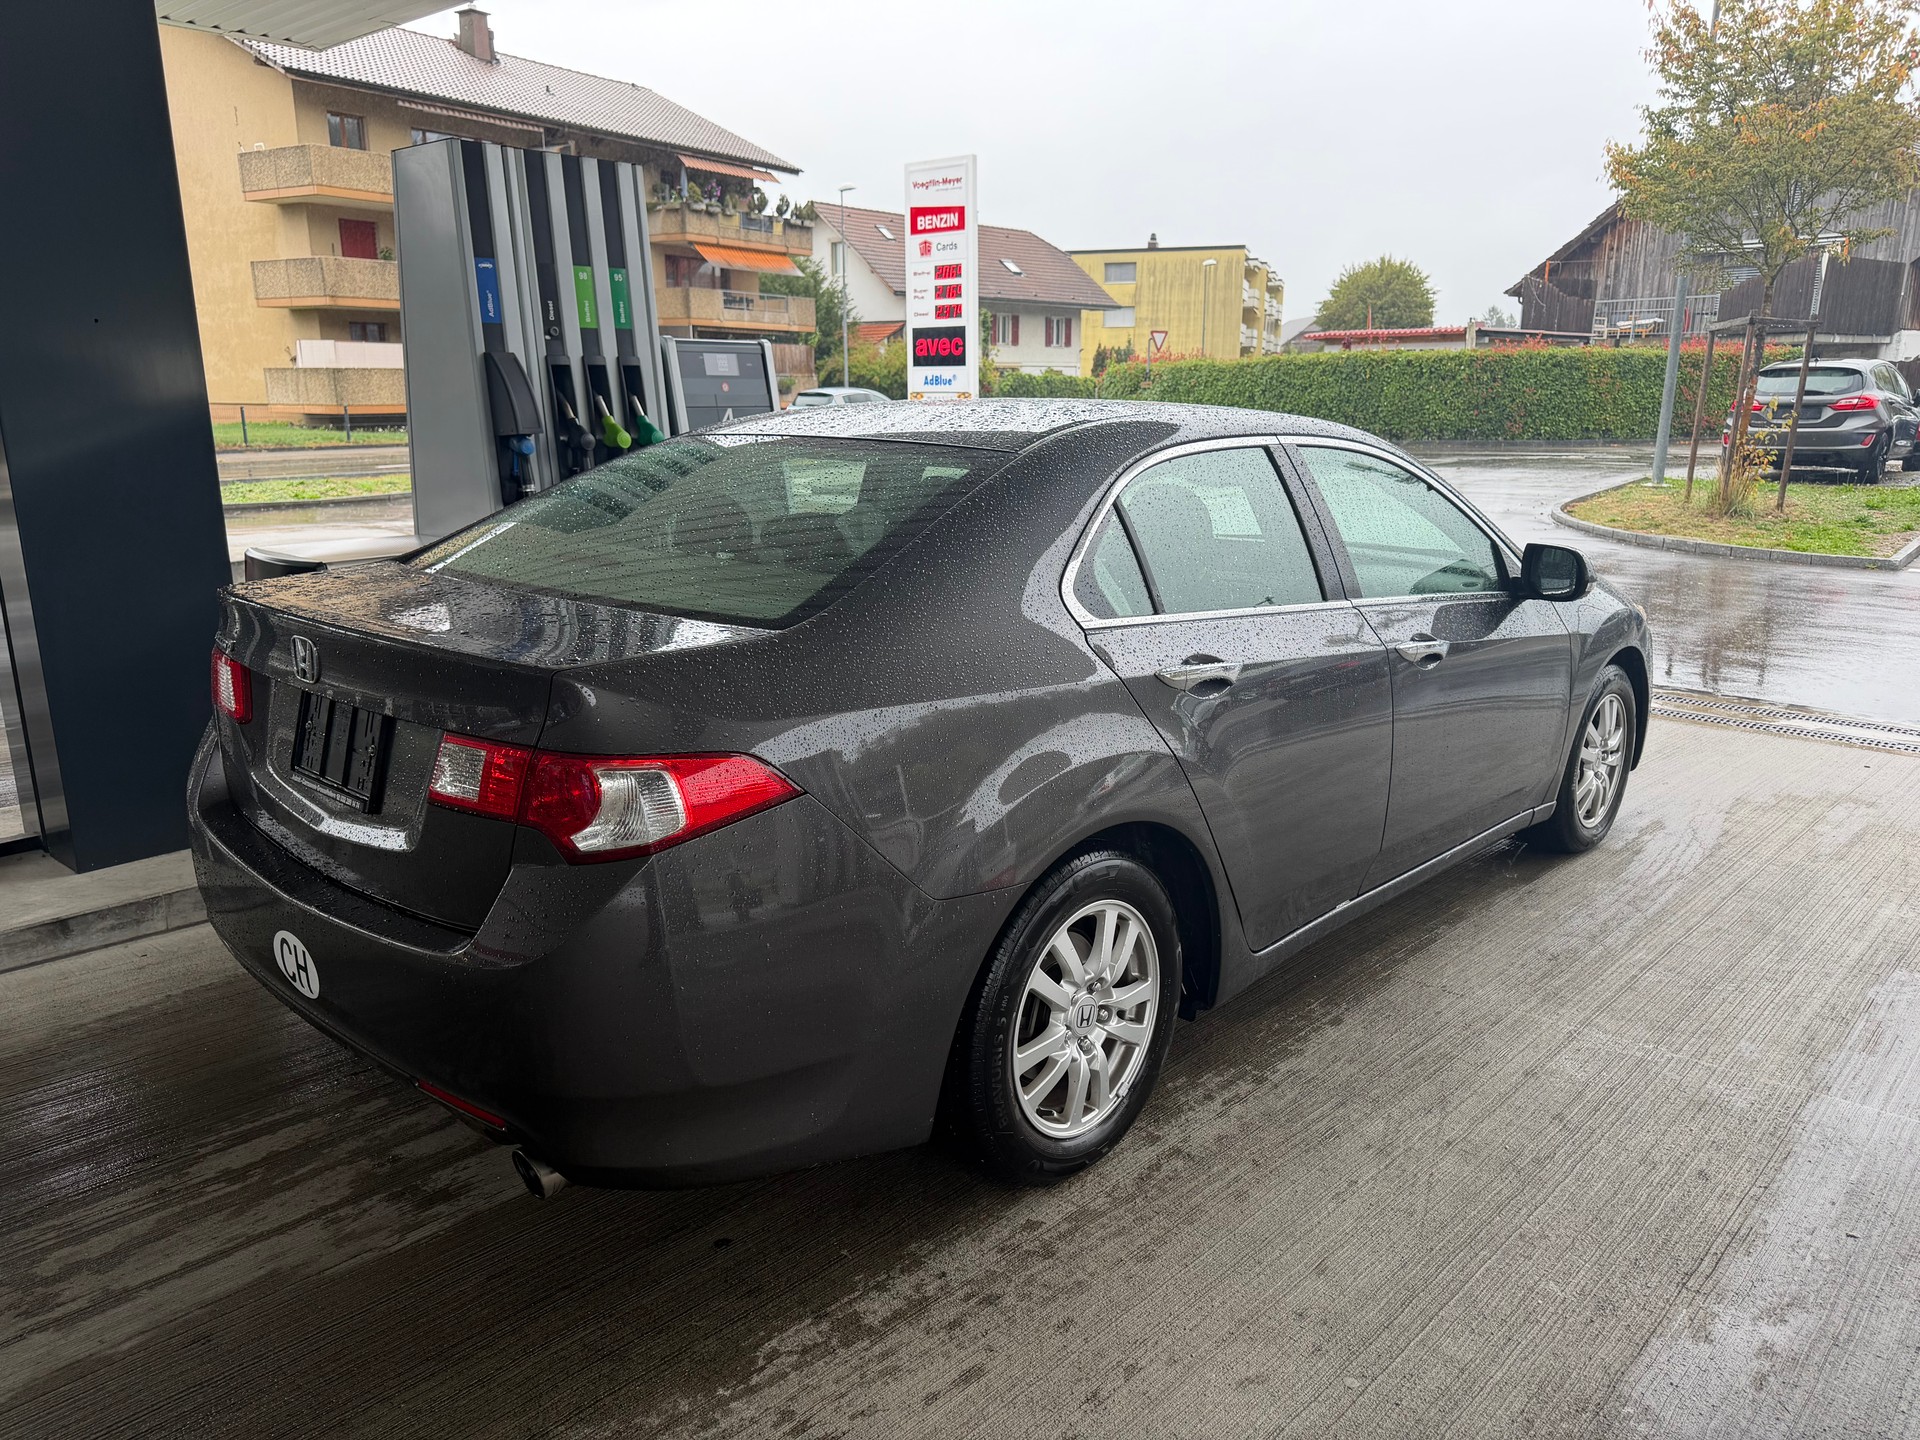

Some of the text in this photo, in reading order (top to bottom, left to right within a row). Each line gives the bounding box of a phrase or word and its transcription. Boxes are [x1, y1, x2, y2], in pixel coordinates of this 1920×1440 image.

[912, 177, 962, 190] Voegtlin-Meyer
[917, 213, 958, 230] BENZIN
[936, 242, 958, 252] Cards
[613, 273, 623, 281] 95
[915, 337, 964, 356] avec
[280, 937, 314, 995] CH
